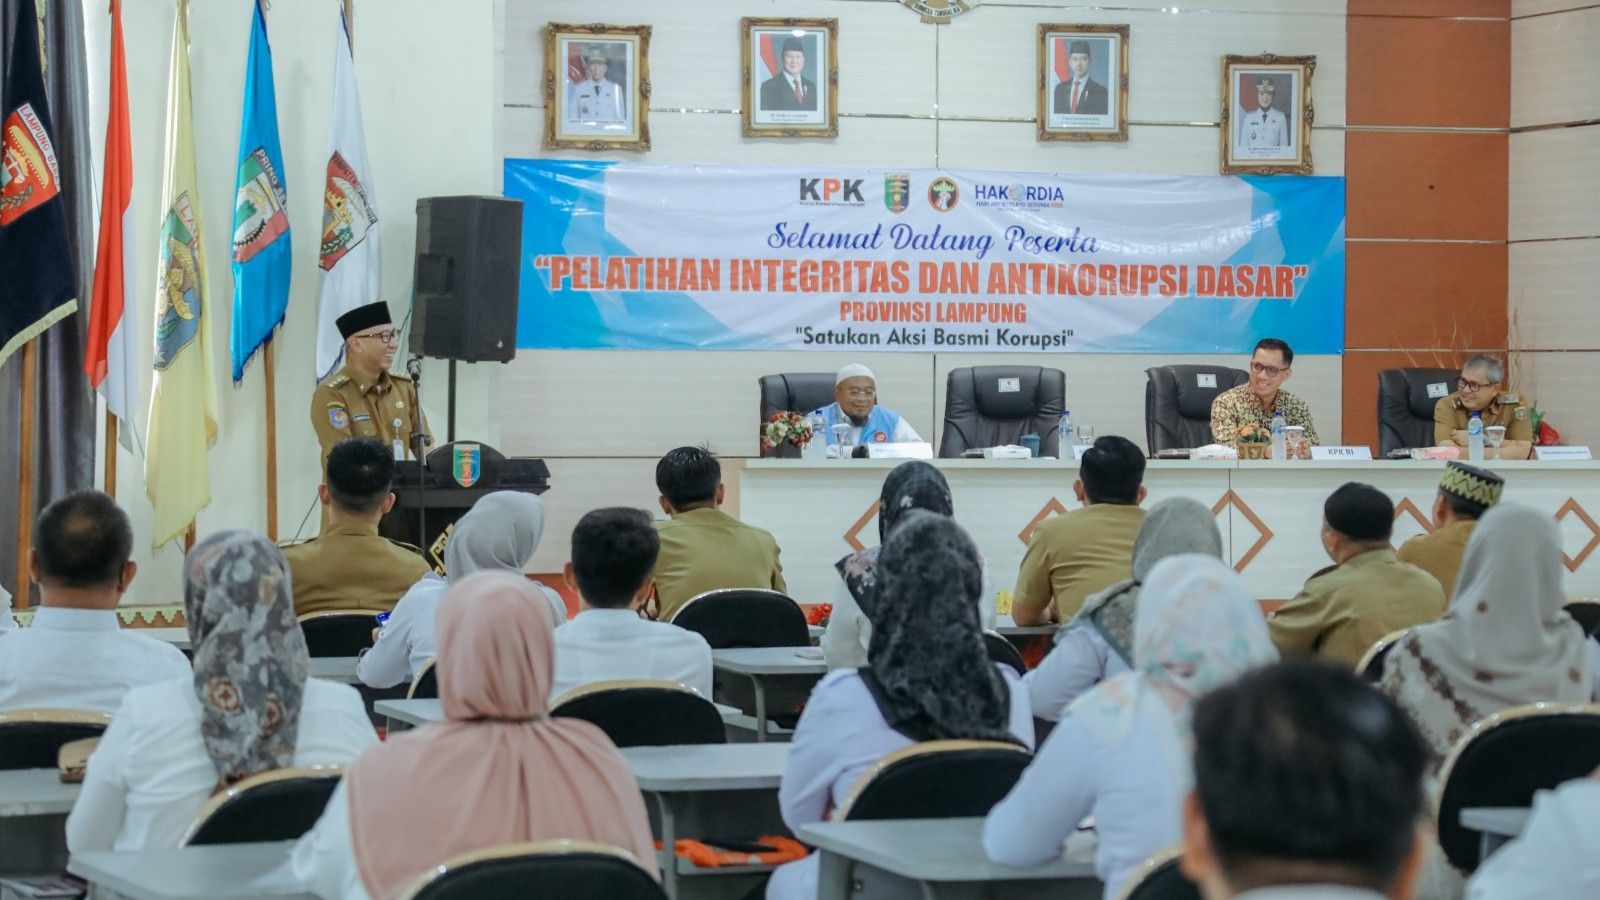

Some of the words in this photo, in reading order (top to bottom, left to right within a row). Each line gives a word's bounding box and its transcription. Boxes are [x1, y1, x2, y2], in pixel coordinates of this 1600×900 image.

[20, 106, 51, 152] LAMPUNG
[800, 178, 865, 201] KPK
[767, 222, 883, 250] Selamat
[890, 222, 995, 259] Datang
[1005, 225, 1100, 255] Peserta
[730, 259, 909, 294] INTEGRITAS
[919, 261, 979, 295] DAN
[987, 263, 1188, 297] ANTIKORUPSI
[840, 302, 931, 322] PROVINSI
[936, 302, 1026, 324] LAMPUNG
[796, 327, 882, 346] "Satukan
[887, 328, 926, 345] Aksi
[934, 329, 990, 346] Basmi
[996, 330, 1074, 349] Korupsi"
[1328, 448, 1344, 456] KPK
[1346, 448, 1354, 456] RI
